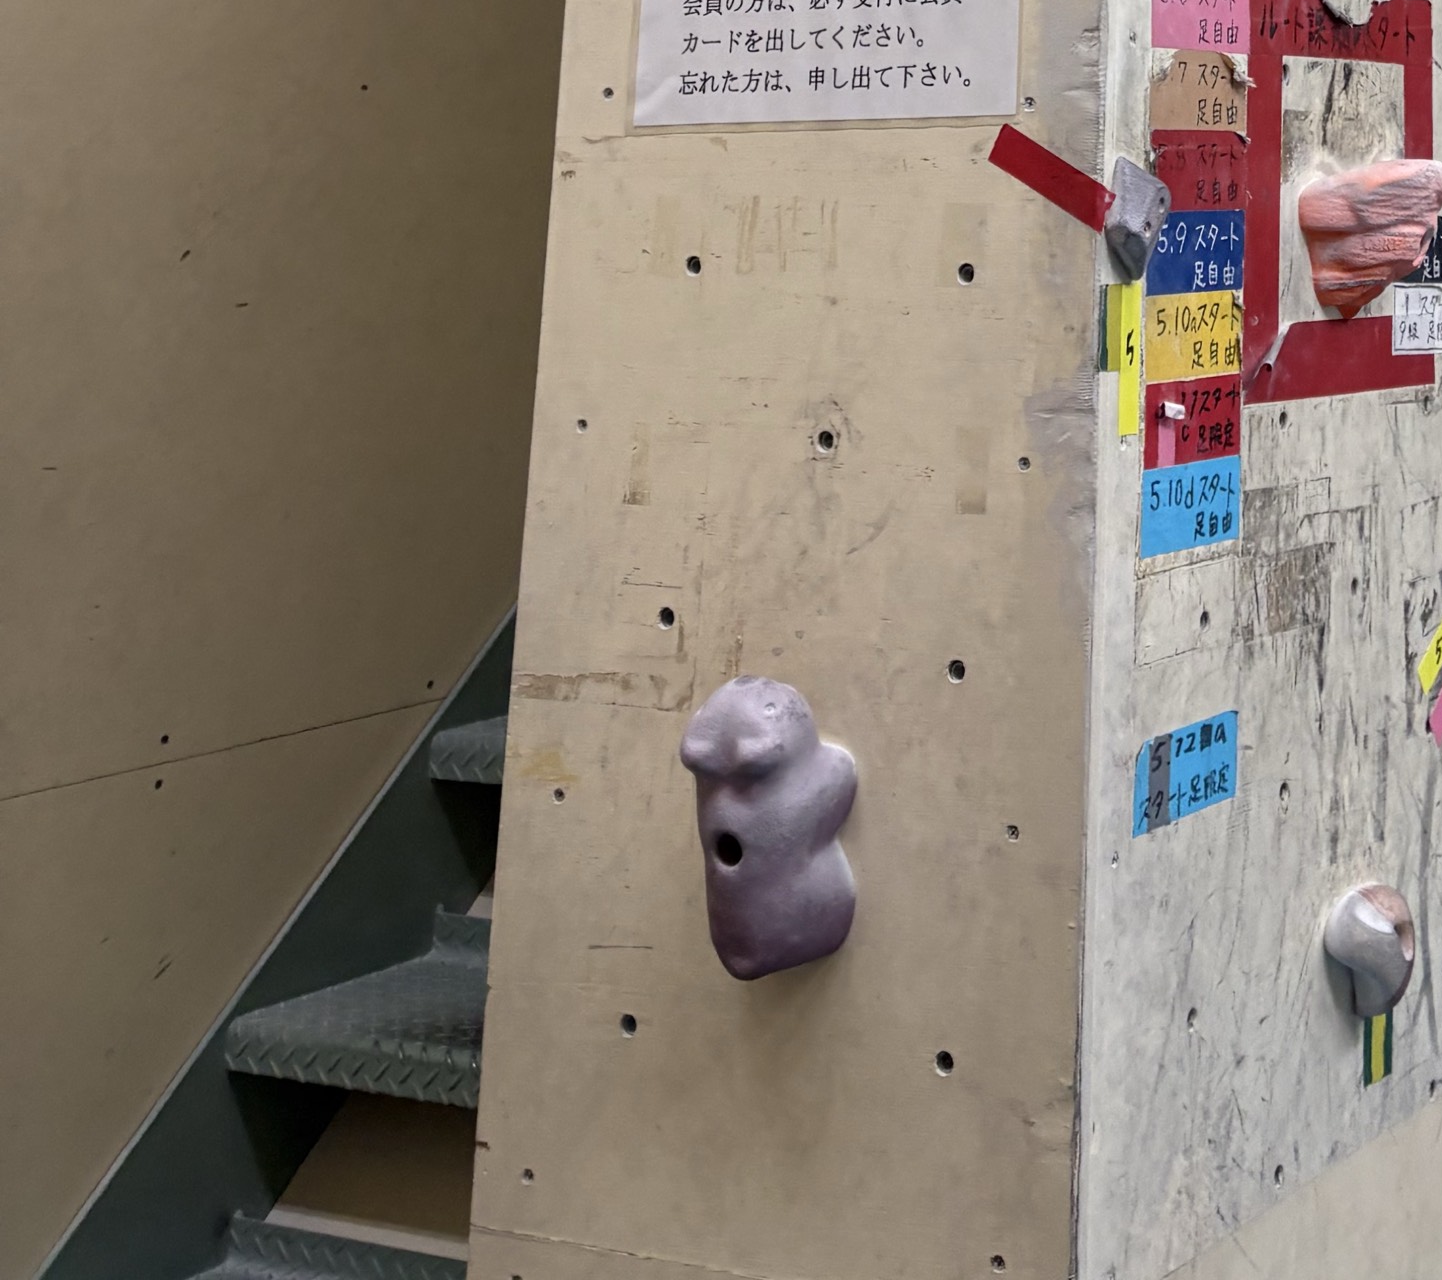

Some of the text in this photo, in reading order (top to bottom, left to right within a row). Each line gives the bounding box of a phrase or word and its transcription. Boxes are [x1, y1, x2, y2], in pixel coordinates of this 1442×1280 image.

[681, 22, 926, 55] カードを出してください。
[1198, 16, 1239, 45] 足自由
[678, 62, 972, 96] 忘れた方は、申し出て下さい。
[1196, 96, 1238, 127] 足自由
[1194, 176, 1238, 206] 足自由
[1157, 221, 1240, 254] 5.9 スタート
[1192, 258, 1235, 290] 足自由
[1125, 328, 1135, 367] 5
[1191, 337, 1236, 370] 足自由
[1193, 509, 1233, 542] 足自由
